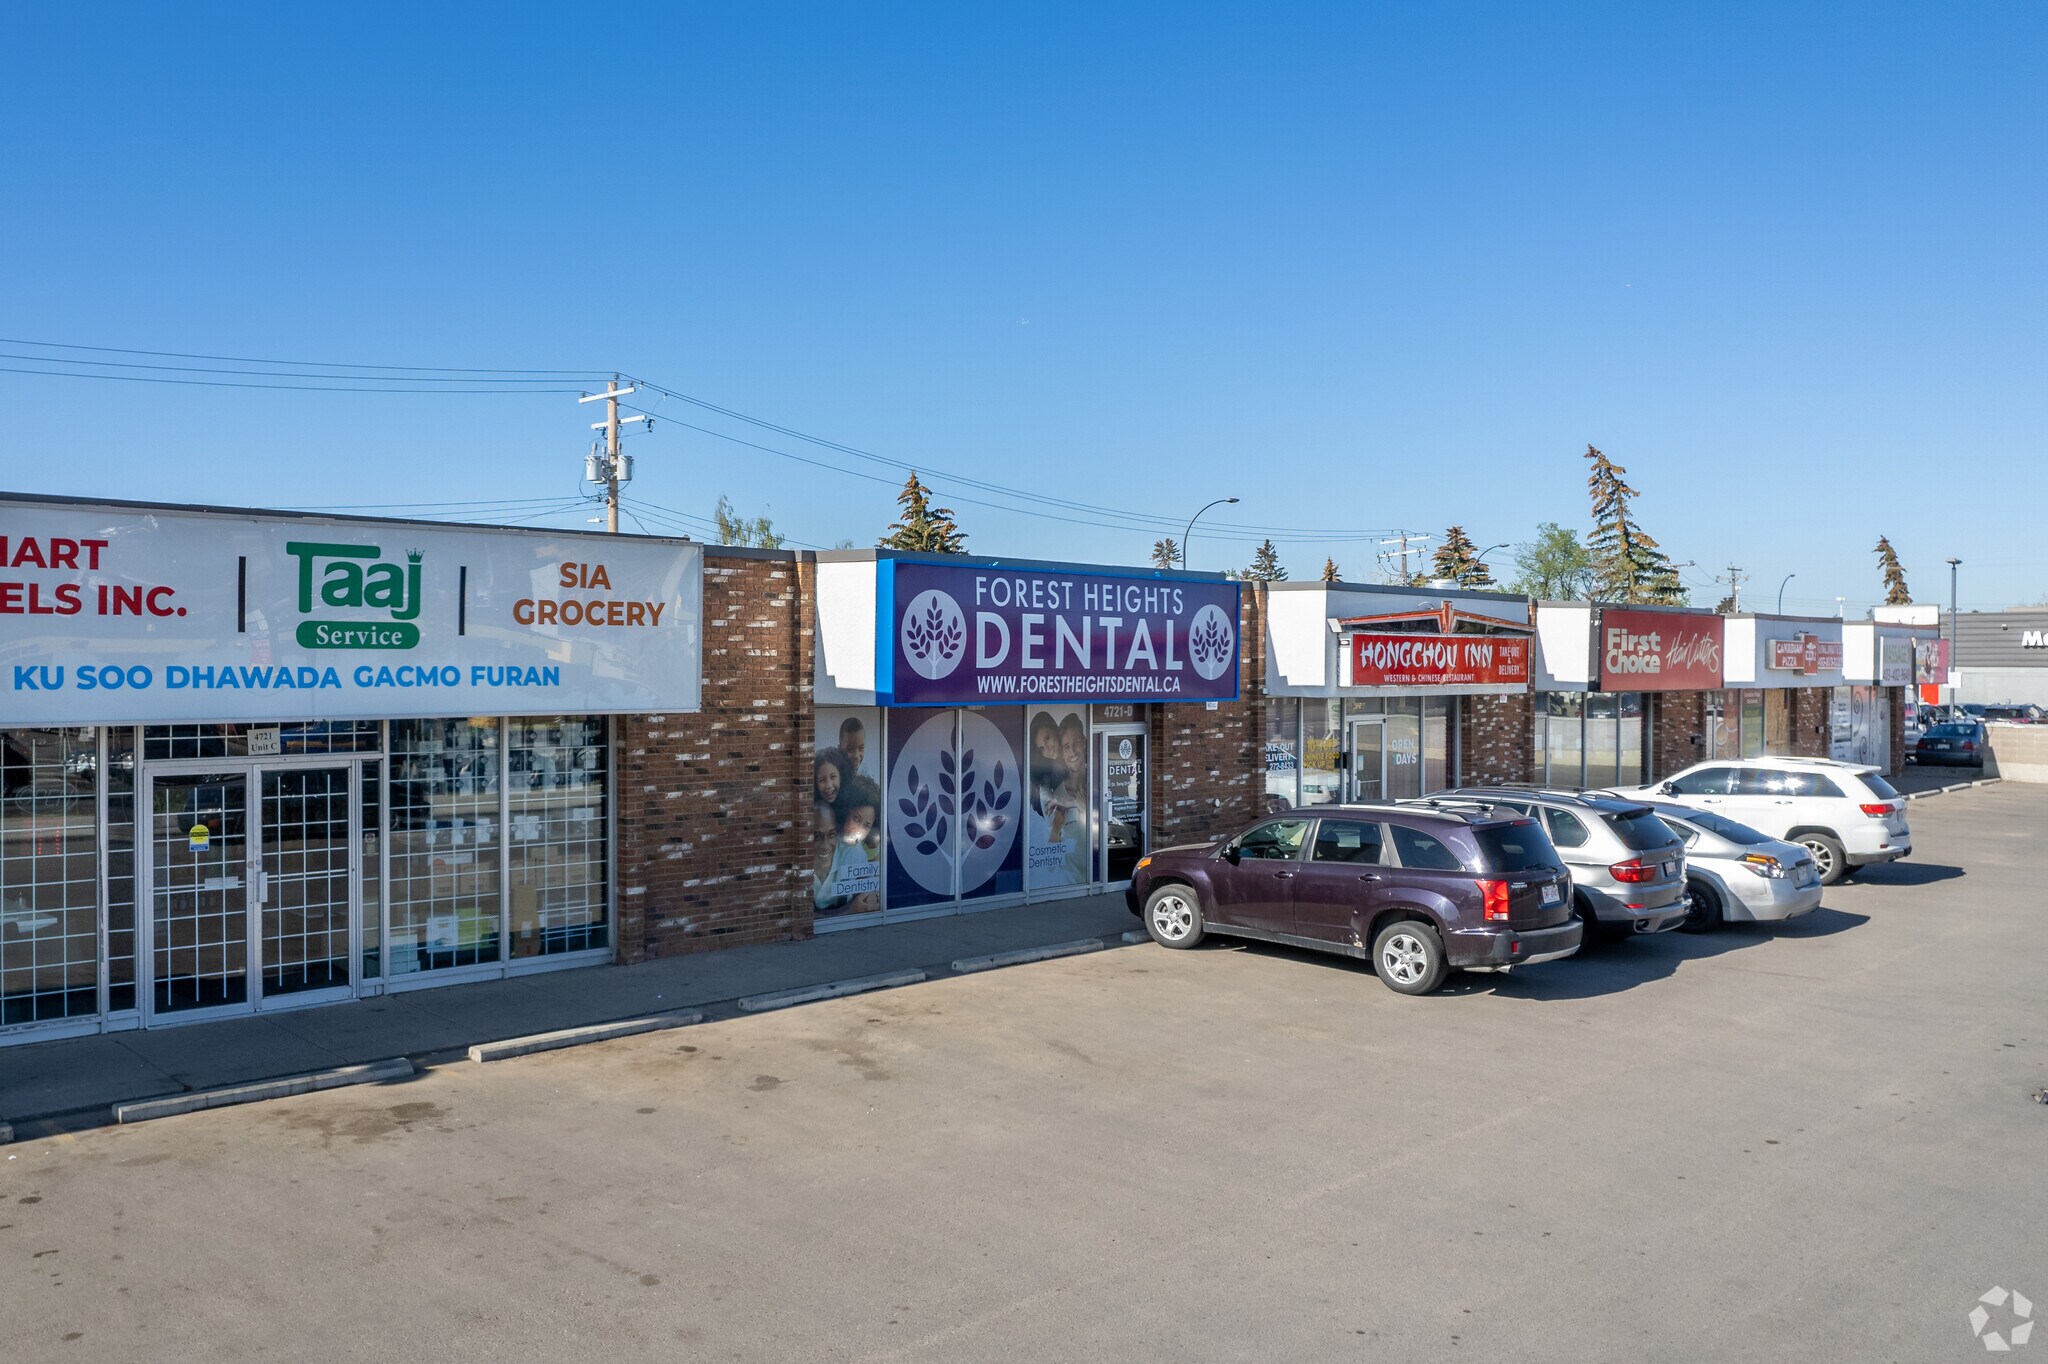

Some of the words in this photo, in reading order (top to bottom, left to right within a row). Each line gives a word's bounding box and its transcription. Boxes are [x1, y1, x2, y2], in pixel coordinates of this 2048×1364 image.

[285, 541, 422, 620] Taaj
[558, 562, 612, 590] SIA
[0, 582, 82, 615] ELS
[97, 584, 188, 617] INC.
[975, 576, 1074, 610] FOREST
[1084, 582, 1184, 615] HEIGHTS
[512, 598, 666, 627] GROCERY
[315, 624, 403, 646] Service
[975, 611, 1184, 671] DENTAL
[1607, 628, 1661, 651] First
[1360, 640, 1458, 669] HONGCHOU
[1464, 643, 1493, 669] INN
[1666, 631, 1688, 670] Hair
[1687, 632, 1719, 673] Cutters
[1776, 643, 1803, 653] CANADIAN
[1606, 649, 1661, 674] Choice
[1782, 656, 1797, 666] PIZZA
[1499, 665, 1520, 675] DELIVERY
[14, 665, 64, 690] KU
[76, 665, 153, 690] SOO
[166, 666, 342, 689] DHAWADA
[353, 665, 461, 688] GACMO
[470, 665, 560, 687] FURAN
[977, 675, 1181, 694] WWW.FORESTHEIGHTSDENTAL.CA
[1384, 674, 1410, 682] WESTERN
[1411, 674, 1417, 682] &
[1417, 674, 1442, 682] CHINESE
[1442, 673, 1475, 682] RESTAURANT
[1104, 705, 1133, 718] 4721-D
[254, 732, 272, 740] 4721
[251, 743, 269, 751] Unit
[270, 742, 278, 750] C
[1391, 738, 1415, 750] OPEN
[1326, 751, 1340, 760] FOOD
[1396, 752, 1417, 765] DAYS
[1109, 764, 1142, 775] DENTAL
[1317, 760, 1326, 768] UP
[1029, 843, 1067, 856] Cosmetic
[1029, 856, 1063, 869] Dentistry
[848, 864, 879, 878] Family
[837, 879, 879, 896] Dentistry
